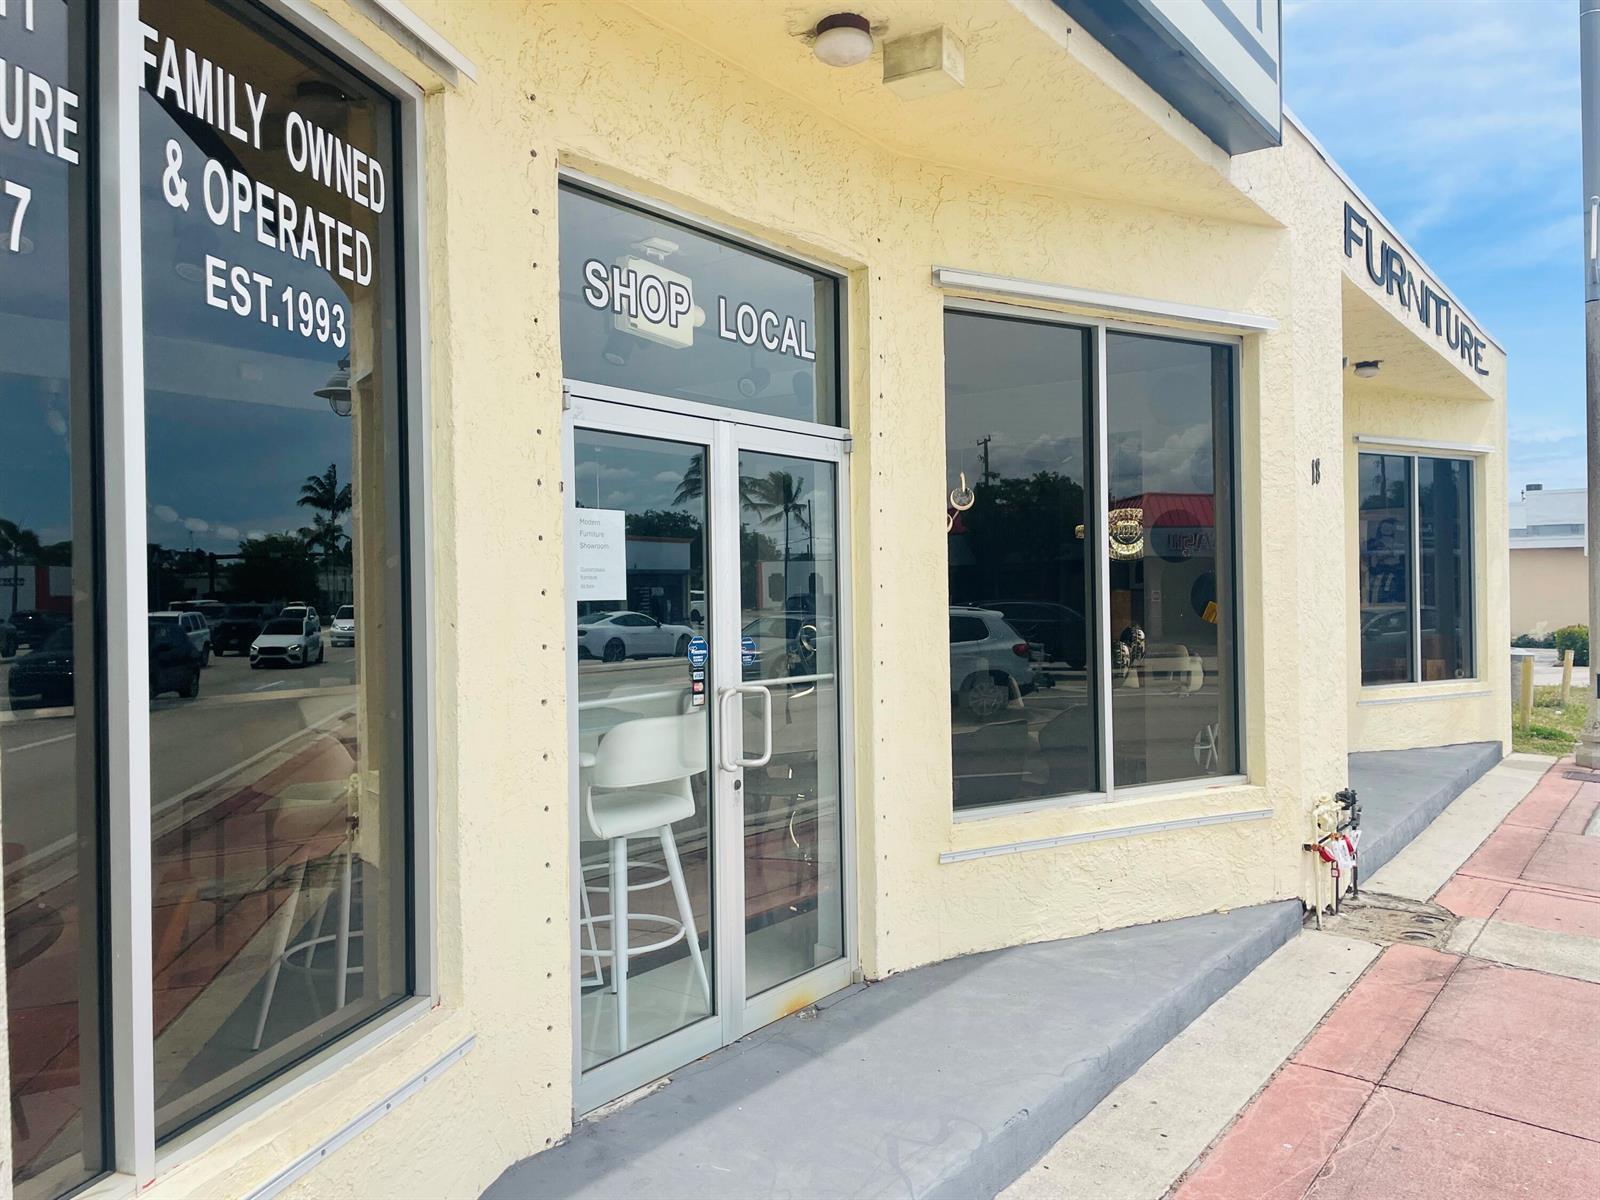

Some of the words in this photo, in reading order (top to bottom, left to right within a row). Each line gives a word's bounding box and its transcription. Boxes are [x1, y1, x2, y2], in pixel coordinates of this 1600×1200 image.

[139, 19, 267, 149] FAMILY
[286, 111, 385, 214] OWNED
[162, 138, 190, 212] &
[203, 158, 372, 287] OPERATED
[205, 254, 346, 348] EST.1993
[583, 258, 691, 327] SHOP
[717, 295, 816, 362] LOCAL
[1344, 201, 1489, 376] FURNITURE
[579, 518, 601, 526] Modern
[579, 530, 605, 538] Furniture
[579, 542, 610, 550] Showroom
